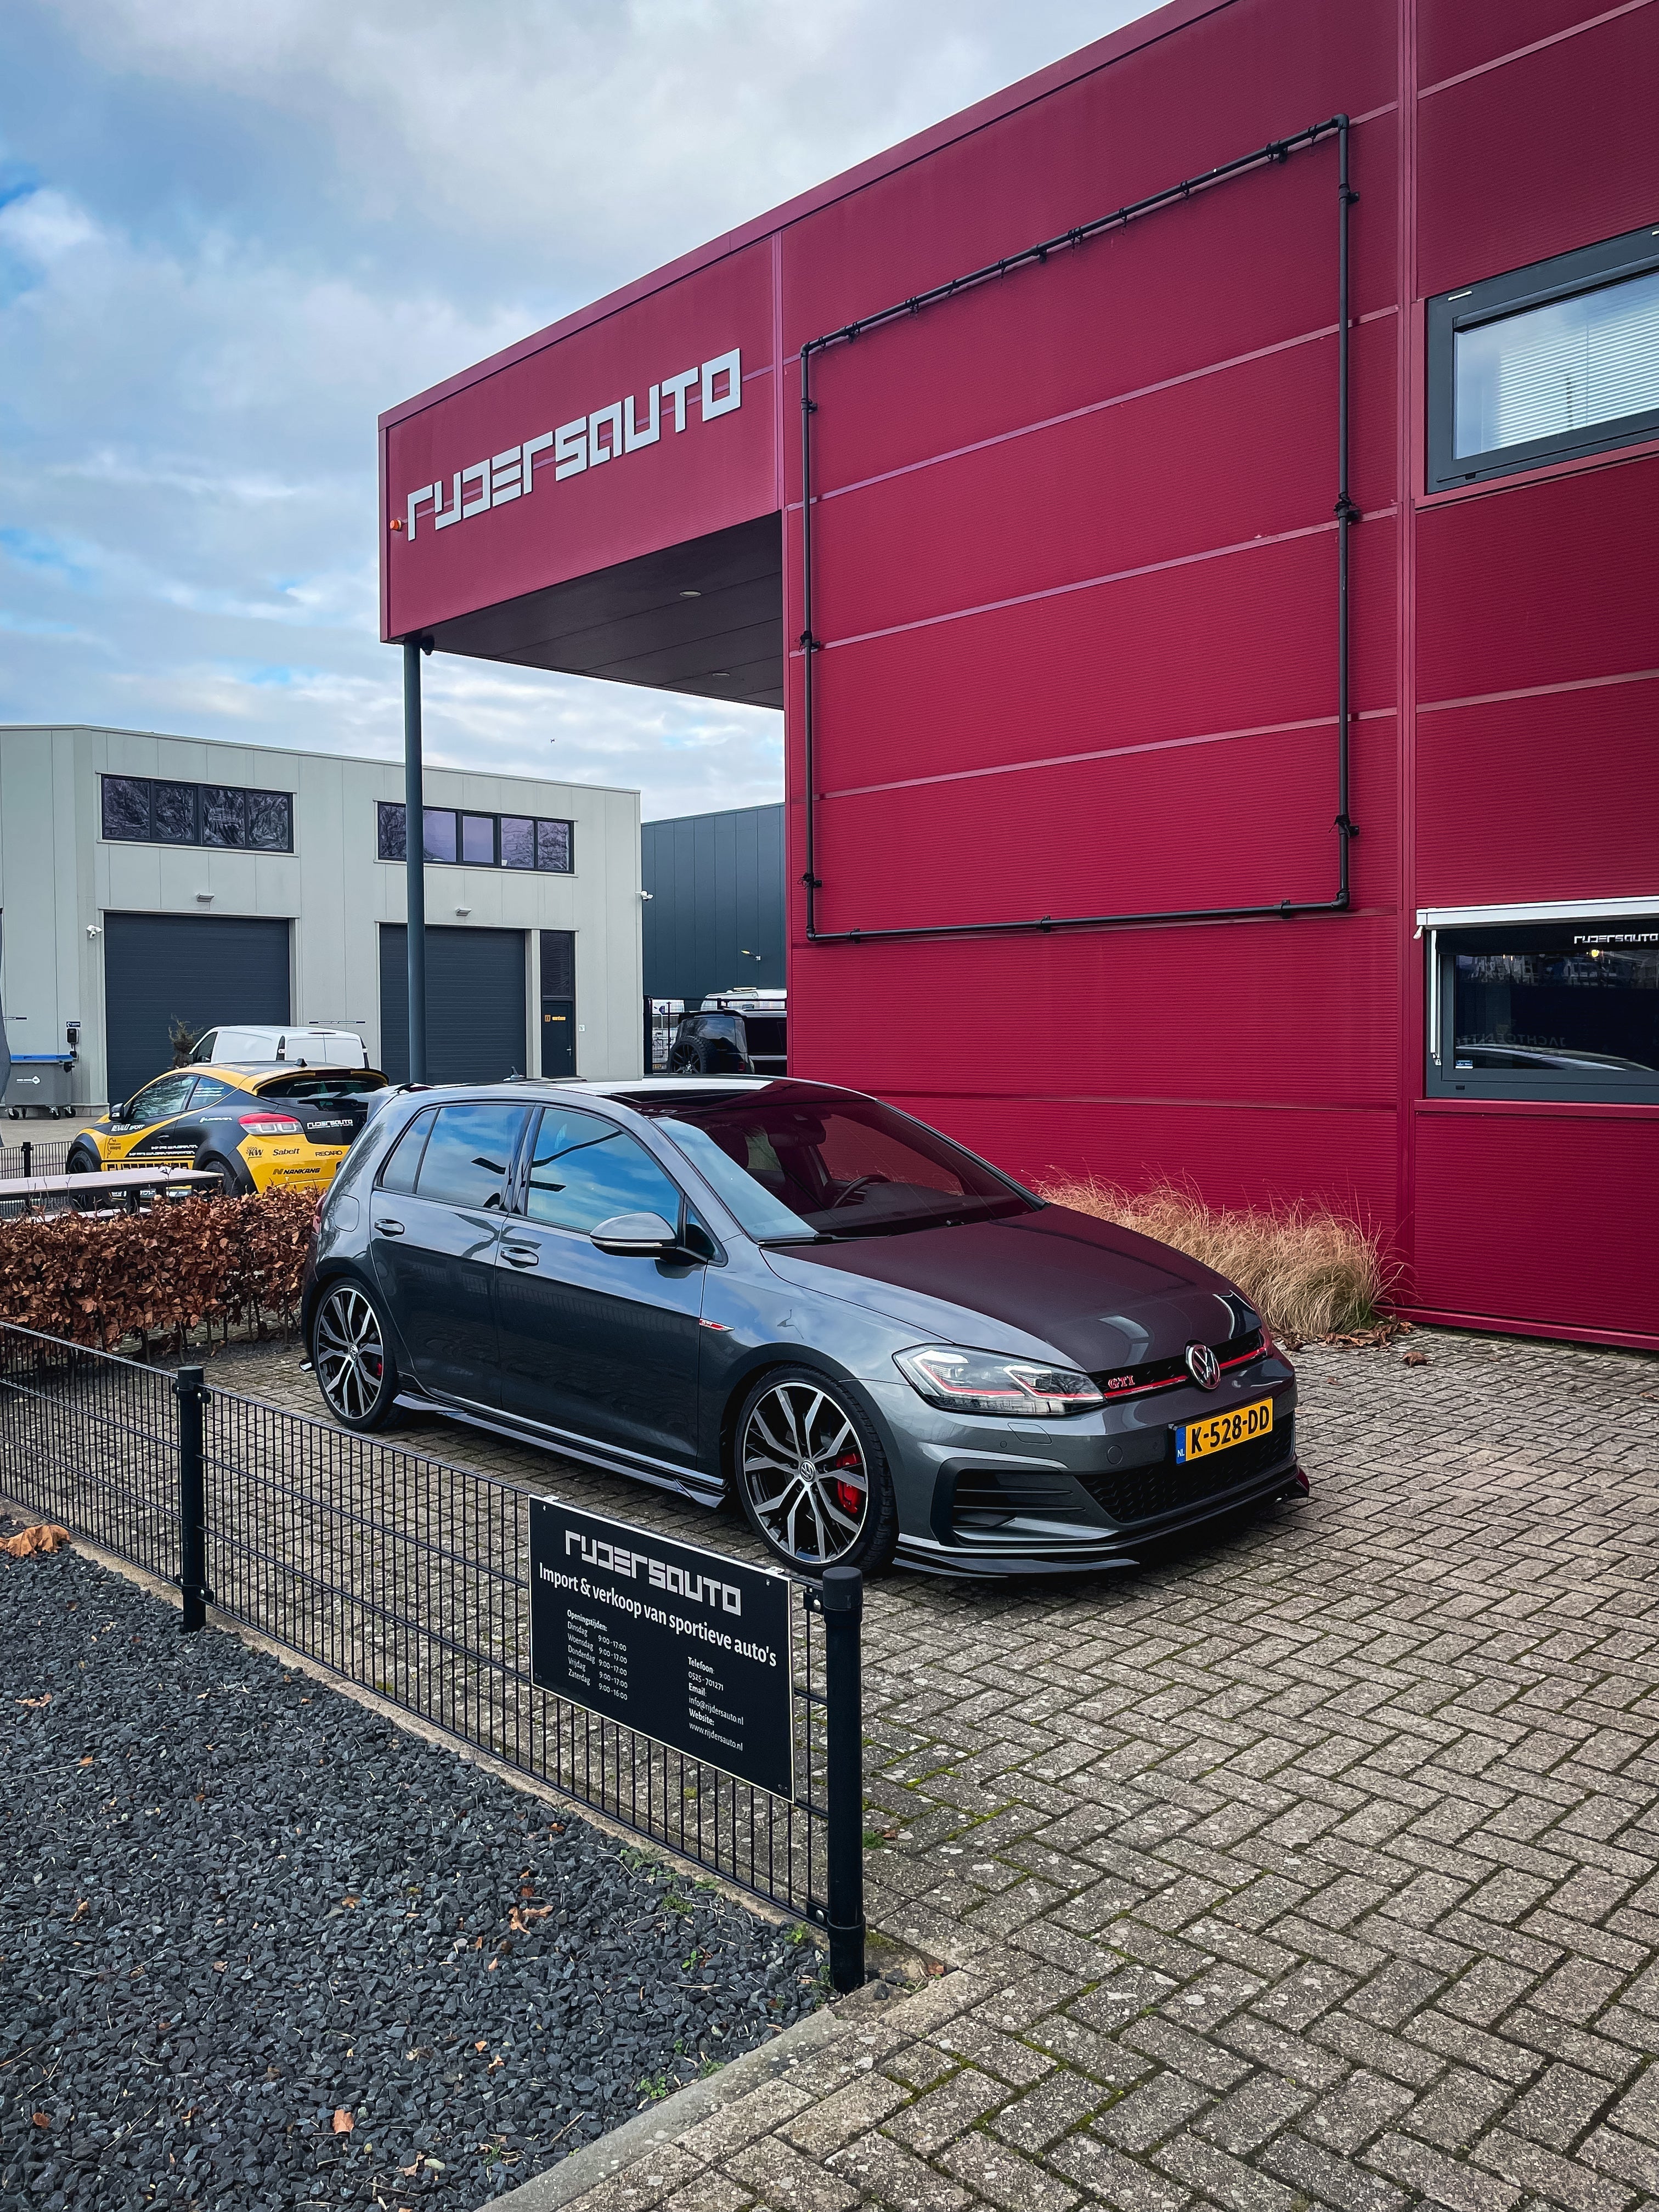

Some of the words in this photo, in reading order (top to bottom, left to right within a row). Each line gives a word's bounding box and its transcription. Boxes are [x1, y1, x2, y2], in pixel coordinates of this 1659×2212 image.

[1108, 1375, 1134, 1389] GTI
[1191, 1406, 1269, 1454] K-528-DD
[1177, 1448, 1185, 1458] NL
[539, 1562, 578, 1592] Import
[580, 1577, 591, 1598] &
[592, 1586, 641, 1618] verkoop
[644, 1604, 666, 1625] van
[669, 1614, 731, 1650] sportieve
[735, 1639, 777, 1667] auto's
[567, 1609, 607, 1632] Openingstijden:
[567, 1621, 588, 1638] Dinsdag
[567, 1633, 594, 1652] Woensdag
[568, 1645, 595, 1664] Donderdag
[568, 1656, 586, 1672] Vrijdag
[688, 1656, 715, 1674] Telefoon:
[568, 1668, 590, 1686] Zaterdag
[689, 1683, 707, 1697] Email:
[689, 1695, 744, 1725] info@rijdersauto.nl
[689, 1708, 714, 1726] Website:
[689, 1722, 743, 1751] www.rijdersauto.nl
